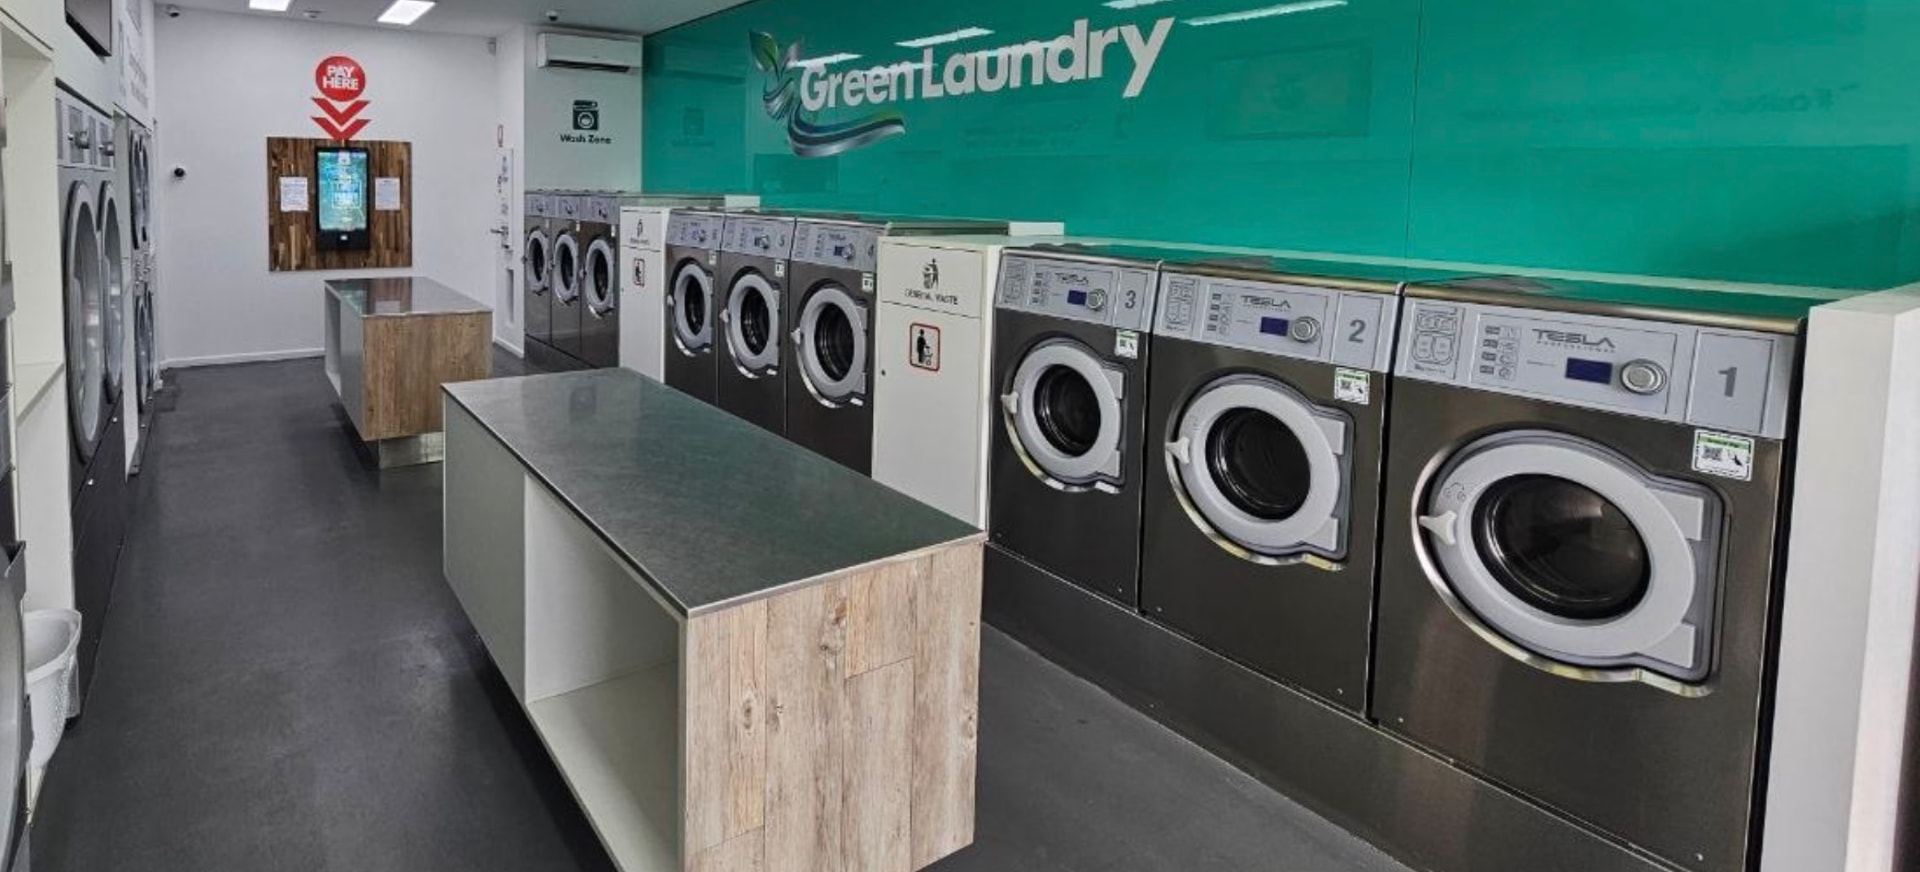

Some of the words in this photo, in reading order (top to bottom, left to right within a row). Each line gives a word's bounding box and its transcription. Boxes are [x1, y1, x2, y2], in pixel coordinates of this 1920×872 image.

[327, 64, 355, 78] PAY
[322, 75, 359, 91] HERE
[560, 134, 586, 143] Wash
[588, 134, 612, 145] Zone
[1124, 290, 1137, 310] 3
[1240, 294, 1291, 309] TESLA
[1348, 319, 1367, 343] 2
[1531, 327, 1616, 349] TESLA
[1717, 366, 1738, 398] 1
